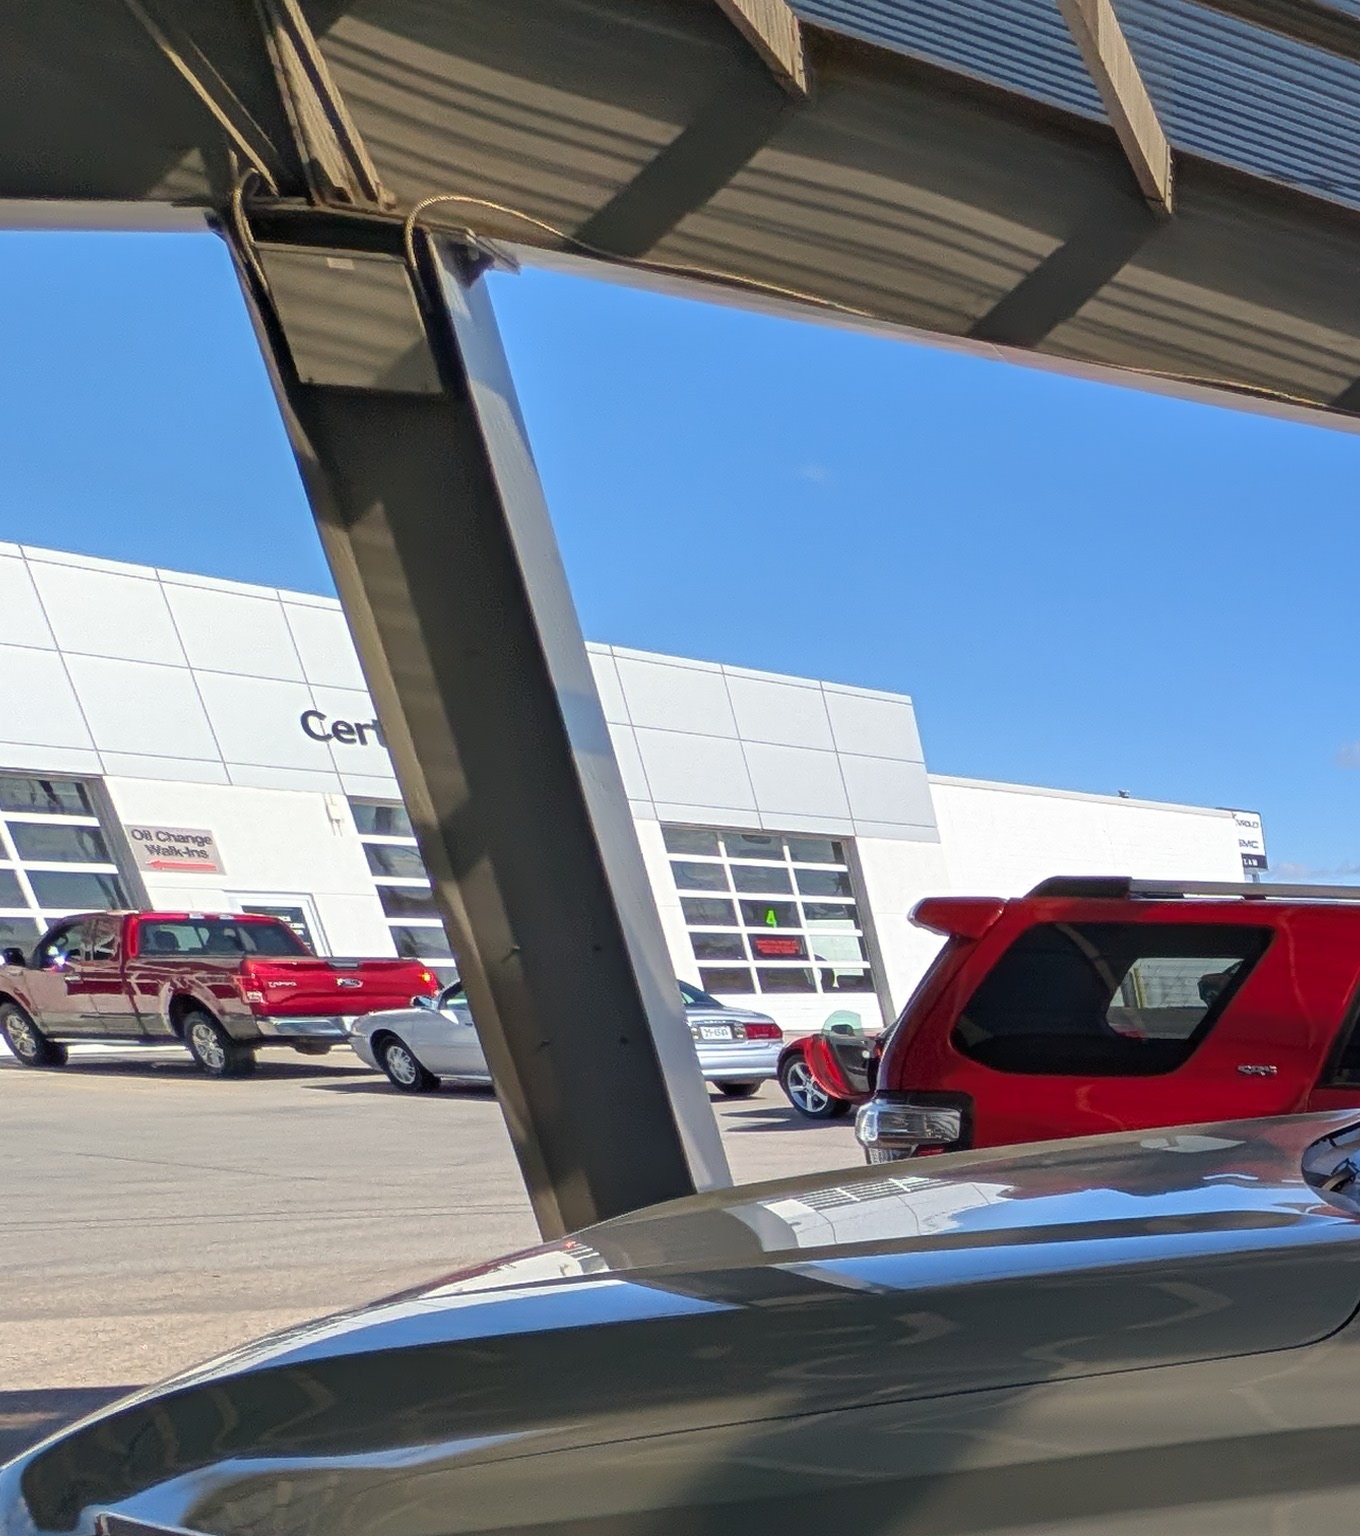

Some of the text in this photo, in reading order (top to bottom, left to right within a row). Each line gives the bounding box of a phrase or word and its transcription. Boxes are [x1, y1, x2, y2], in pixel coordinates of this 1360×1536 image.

[131, 829, 213, 847] Oil Change
[145, 844, 209, 859] Walk-Ins
[766, 909, 777, 928] 4
